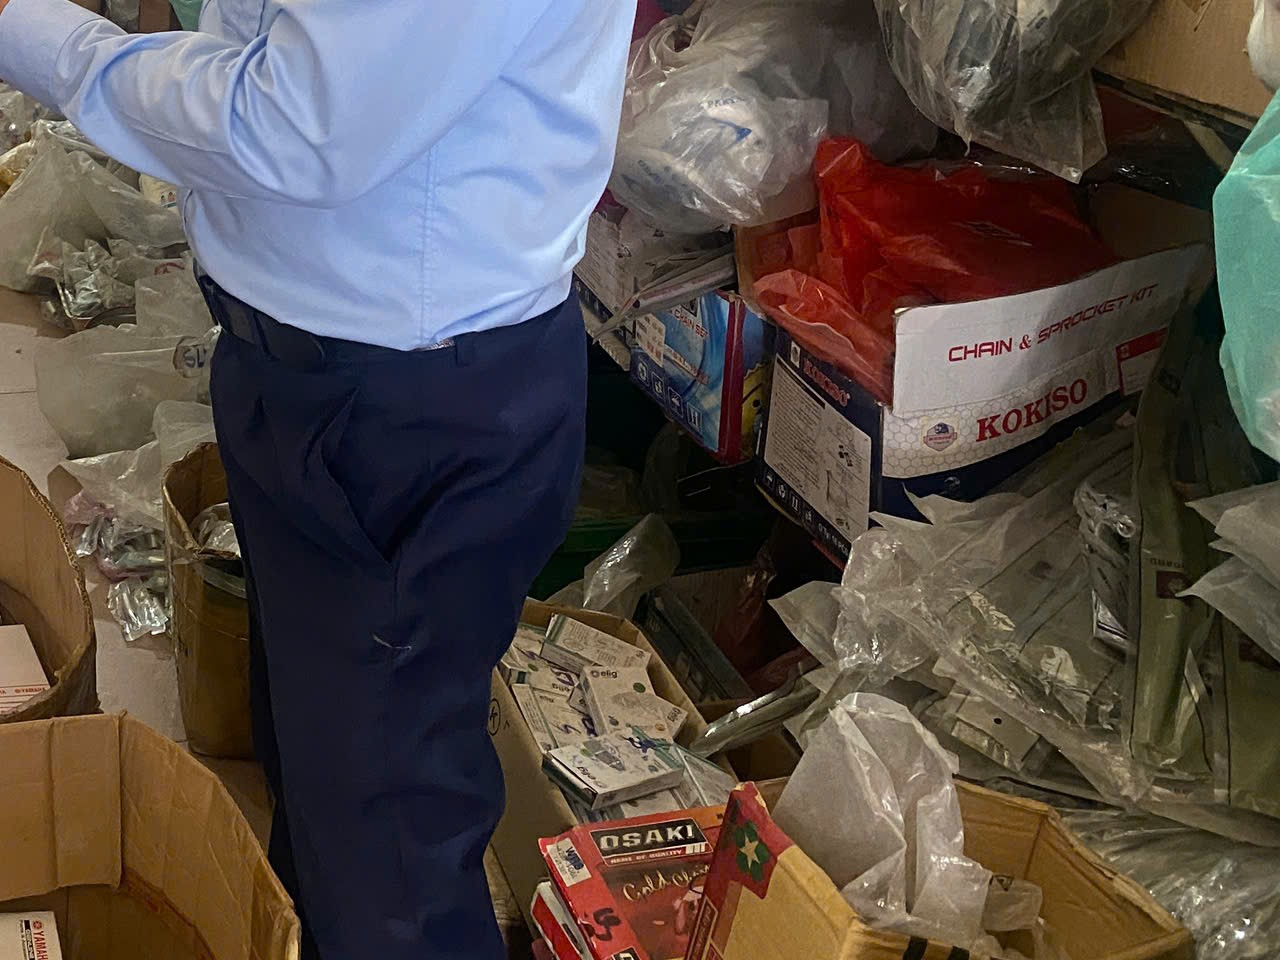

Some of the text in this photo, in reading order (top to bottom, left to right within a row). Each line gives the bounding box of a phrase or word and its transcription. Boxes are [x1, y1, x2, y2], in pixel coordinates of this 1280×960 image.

[948, 283, 1159, 362] CHAIN & SPROCKET KIT
[975, 378, 1089, 442] KOKISO
[600, 824, 696, 851] OSAKI
